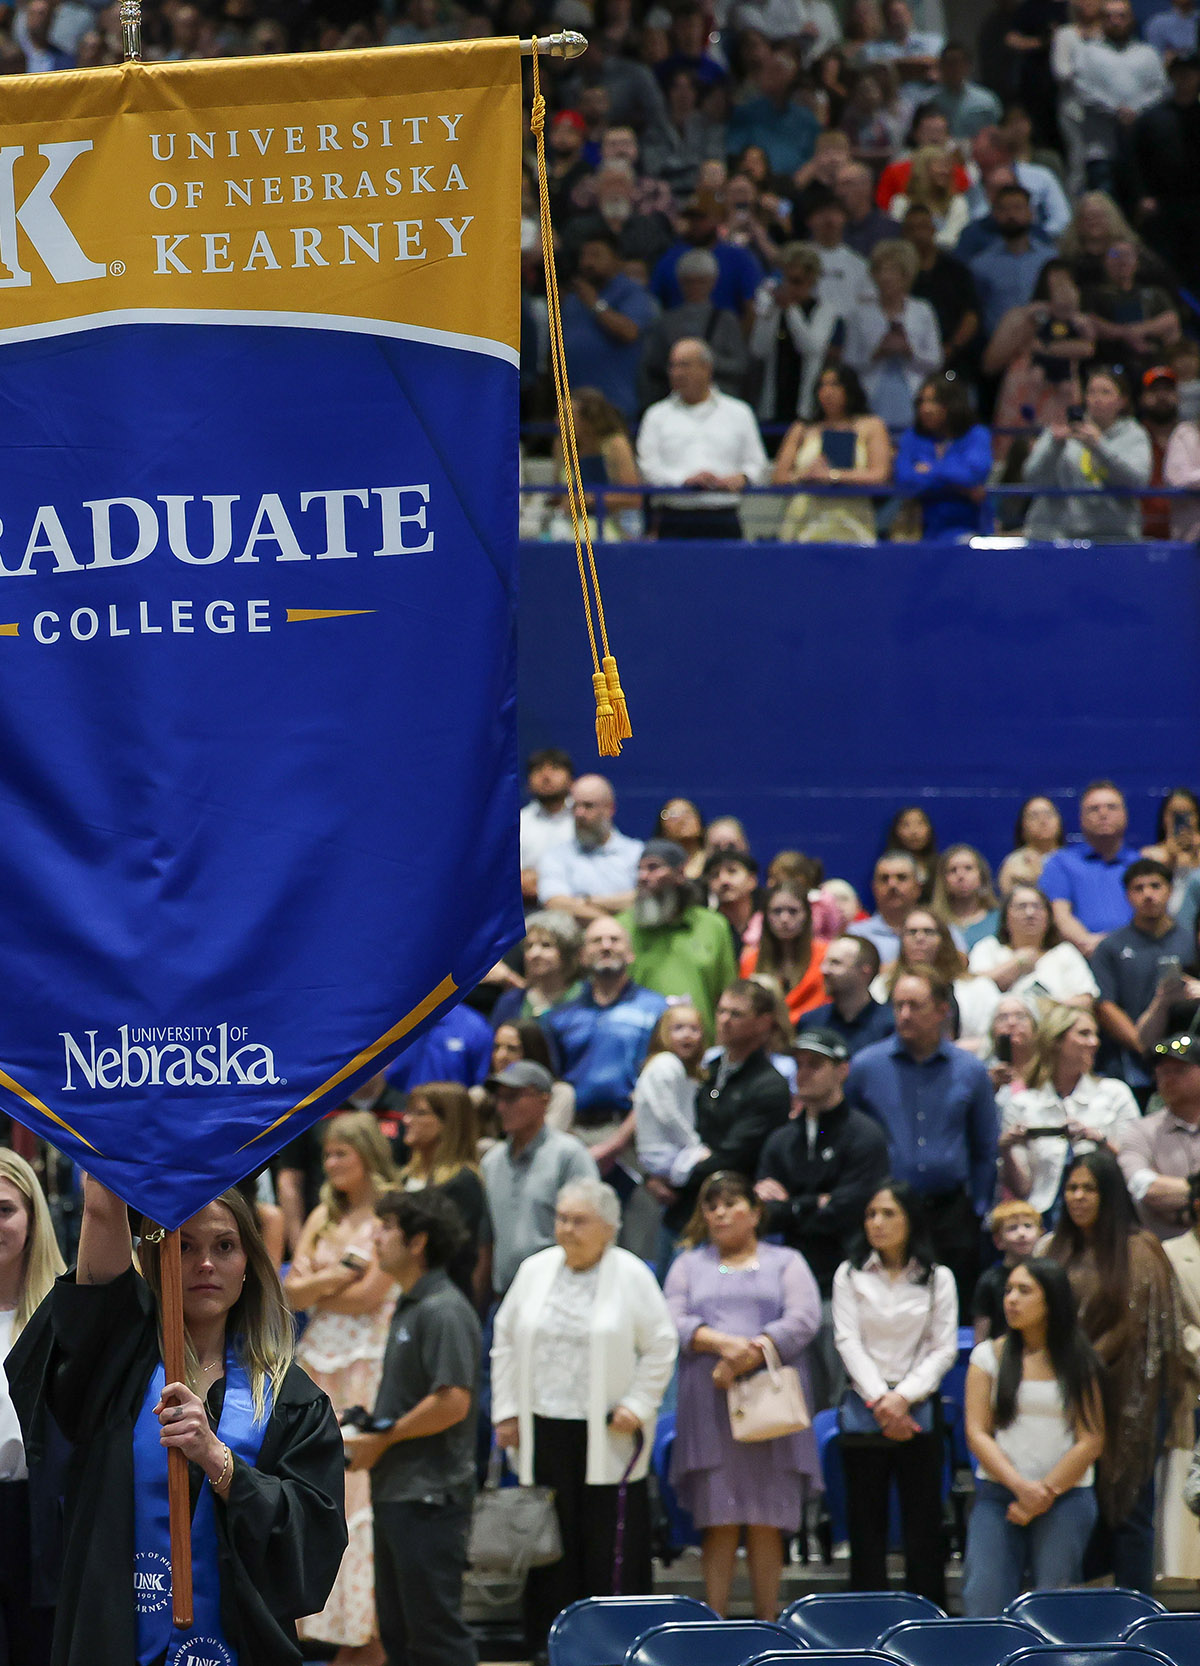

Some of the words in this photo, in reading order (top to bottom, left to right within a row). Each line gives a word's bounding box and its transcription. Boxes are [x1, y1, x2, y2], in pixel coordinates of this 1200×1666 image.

[148, 113, 465, 161] UNIVERSITY
[149, 181, 204, 210] OF
[223, 163, 469, 208] NEBRASKA
[151, 215, 475, 275] KEARNEY
[32, 599, 272, 645] COLLEGE
[131, 1026, 213, 1043] UNIVERSITY
[230, 1026, 249, 1042] OF
[147, 1551, 160, 1560] OF
[137, 1592, 156, 1601] 1905
[173, 1636, 205, 1666] NIVERSITY
[206, 1637, 217, 1645] OF
